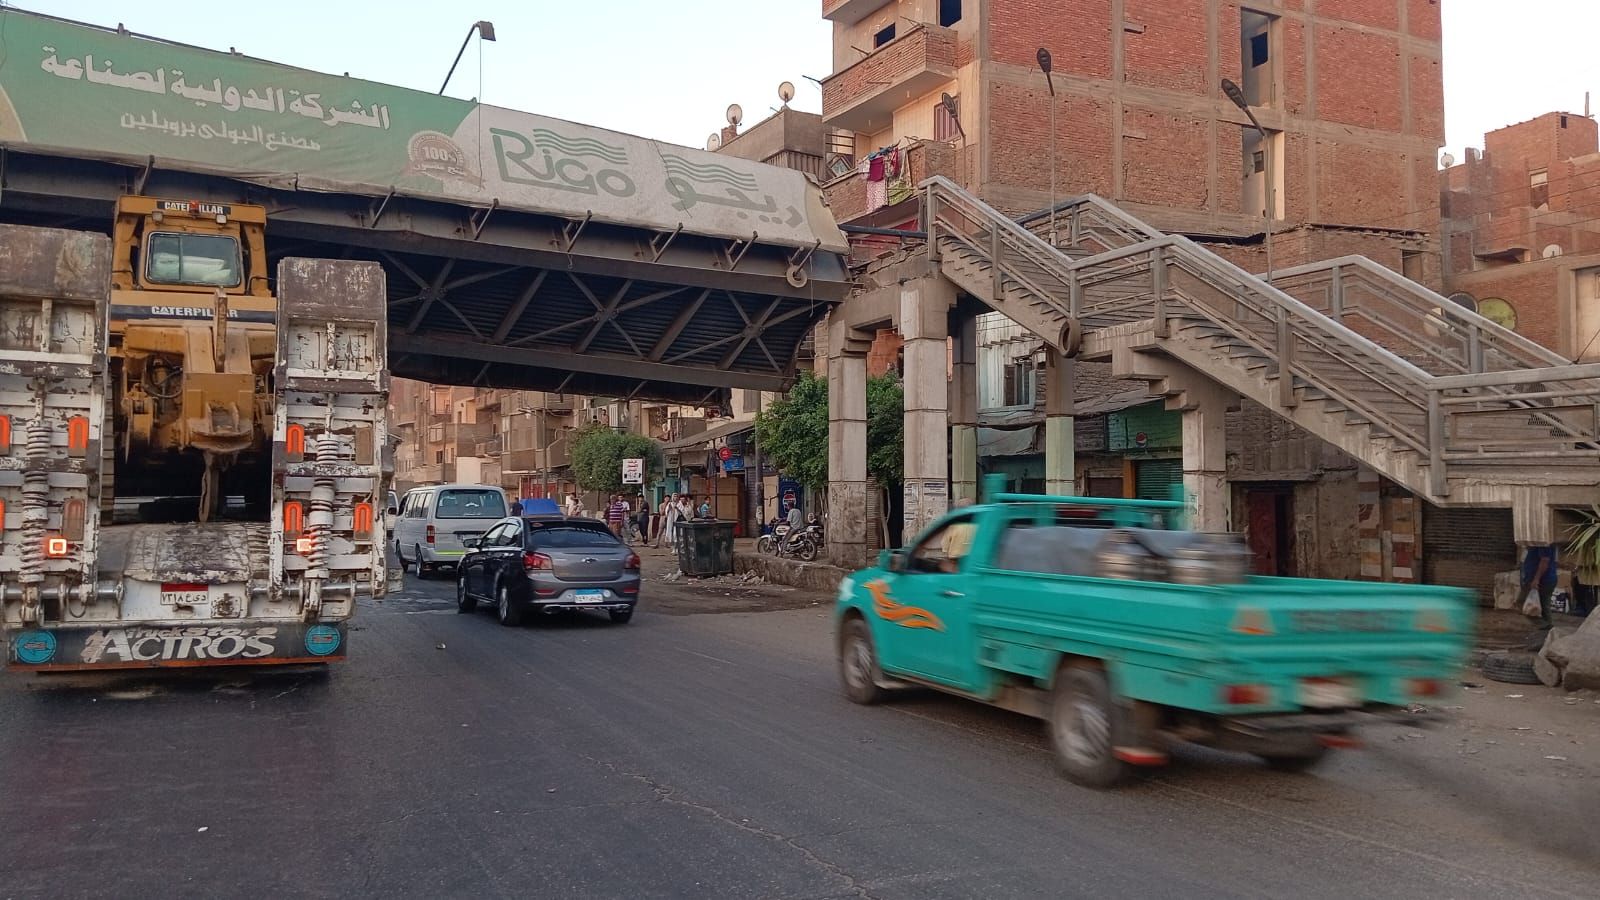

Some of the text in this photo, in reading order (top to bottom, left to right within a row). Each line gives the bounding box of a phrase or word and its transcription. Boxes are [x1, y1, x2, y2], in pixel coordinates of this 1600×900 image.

[40, 46, 390, 131] الشركة الدولية لصناعة
[120, 110, 196, 138] بروبلين
[265, 131, 321, 152] مصنع
[164, 201, 224, 214] CATEILLAR
[665, 176, 803, 229] ريجو
[151, 306, 238, 318] CATERPILR
